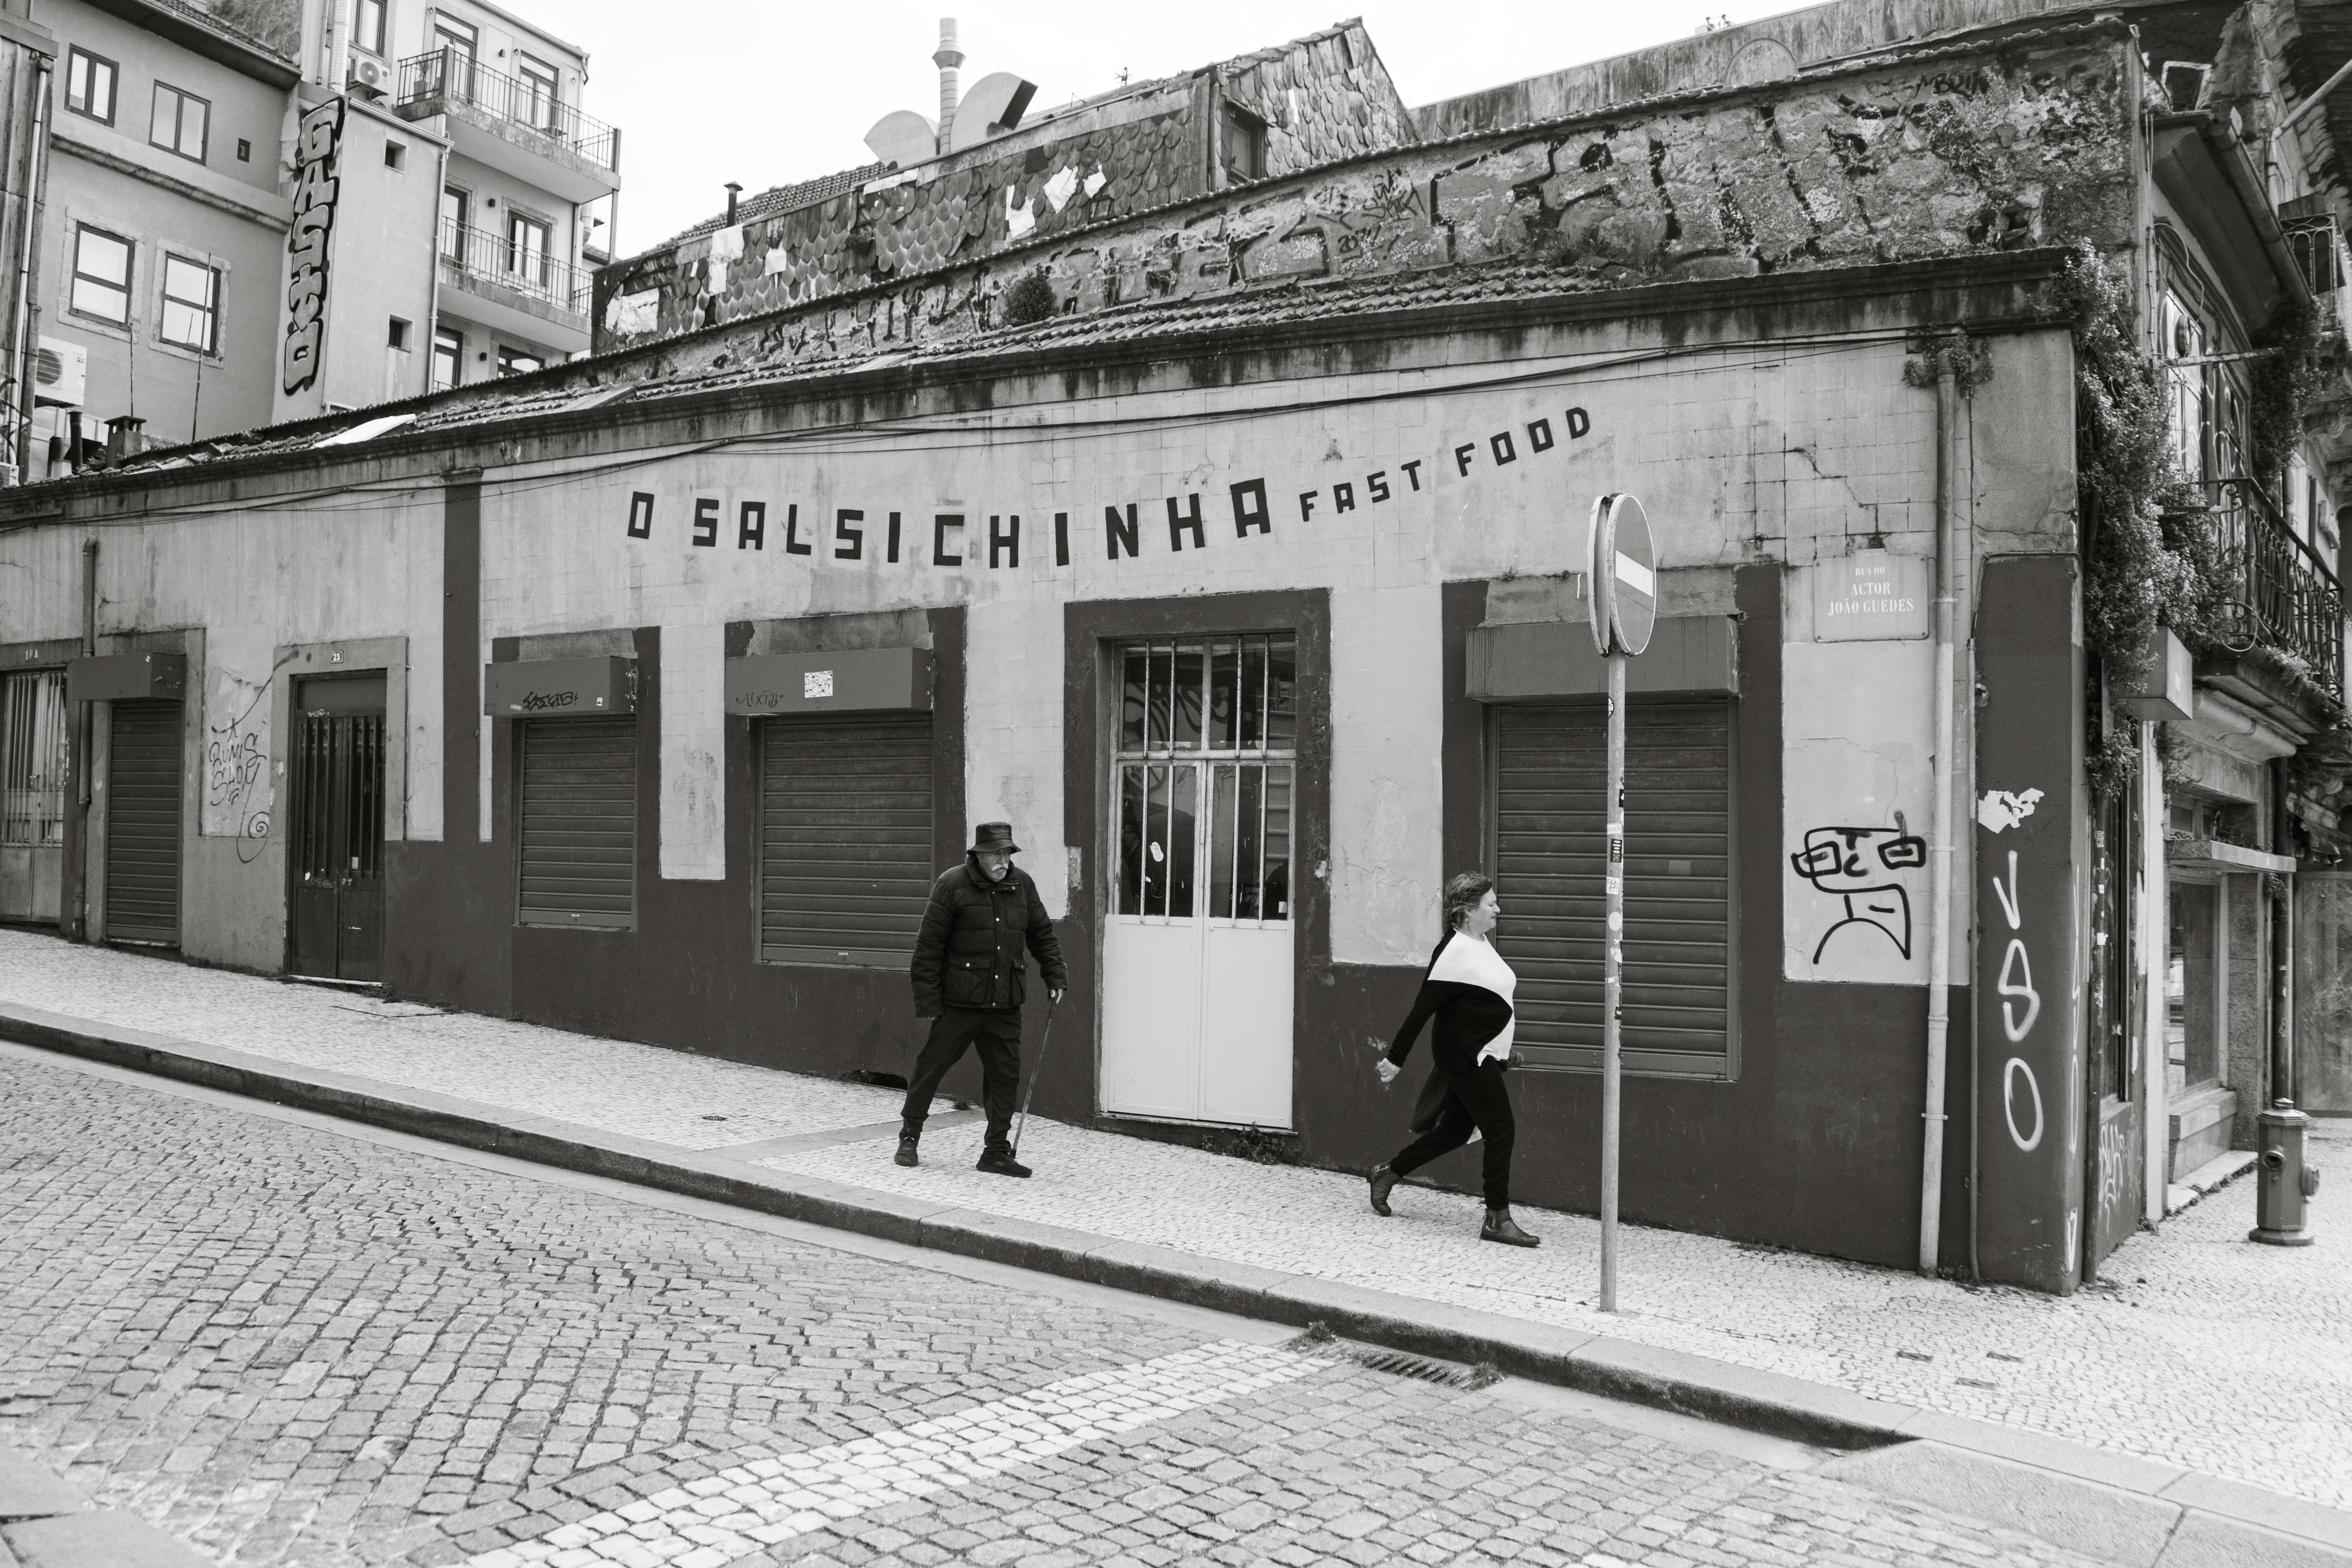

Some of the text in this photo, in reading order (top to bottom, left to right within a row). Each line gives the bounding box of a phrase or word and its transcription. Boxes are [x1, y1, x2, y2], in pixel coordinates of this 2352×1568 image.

[627, 407, 1590, 569] O SALSICHINHA FAST FOOD
[1856, 566, 1885, 576] RUA DO
[1851, 582, 1891, 596] ACTOR
[1828, 598, 1914, 616] JOÃO GUEDES
[333, 653, 340, 661] 23
